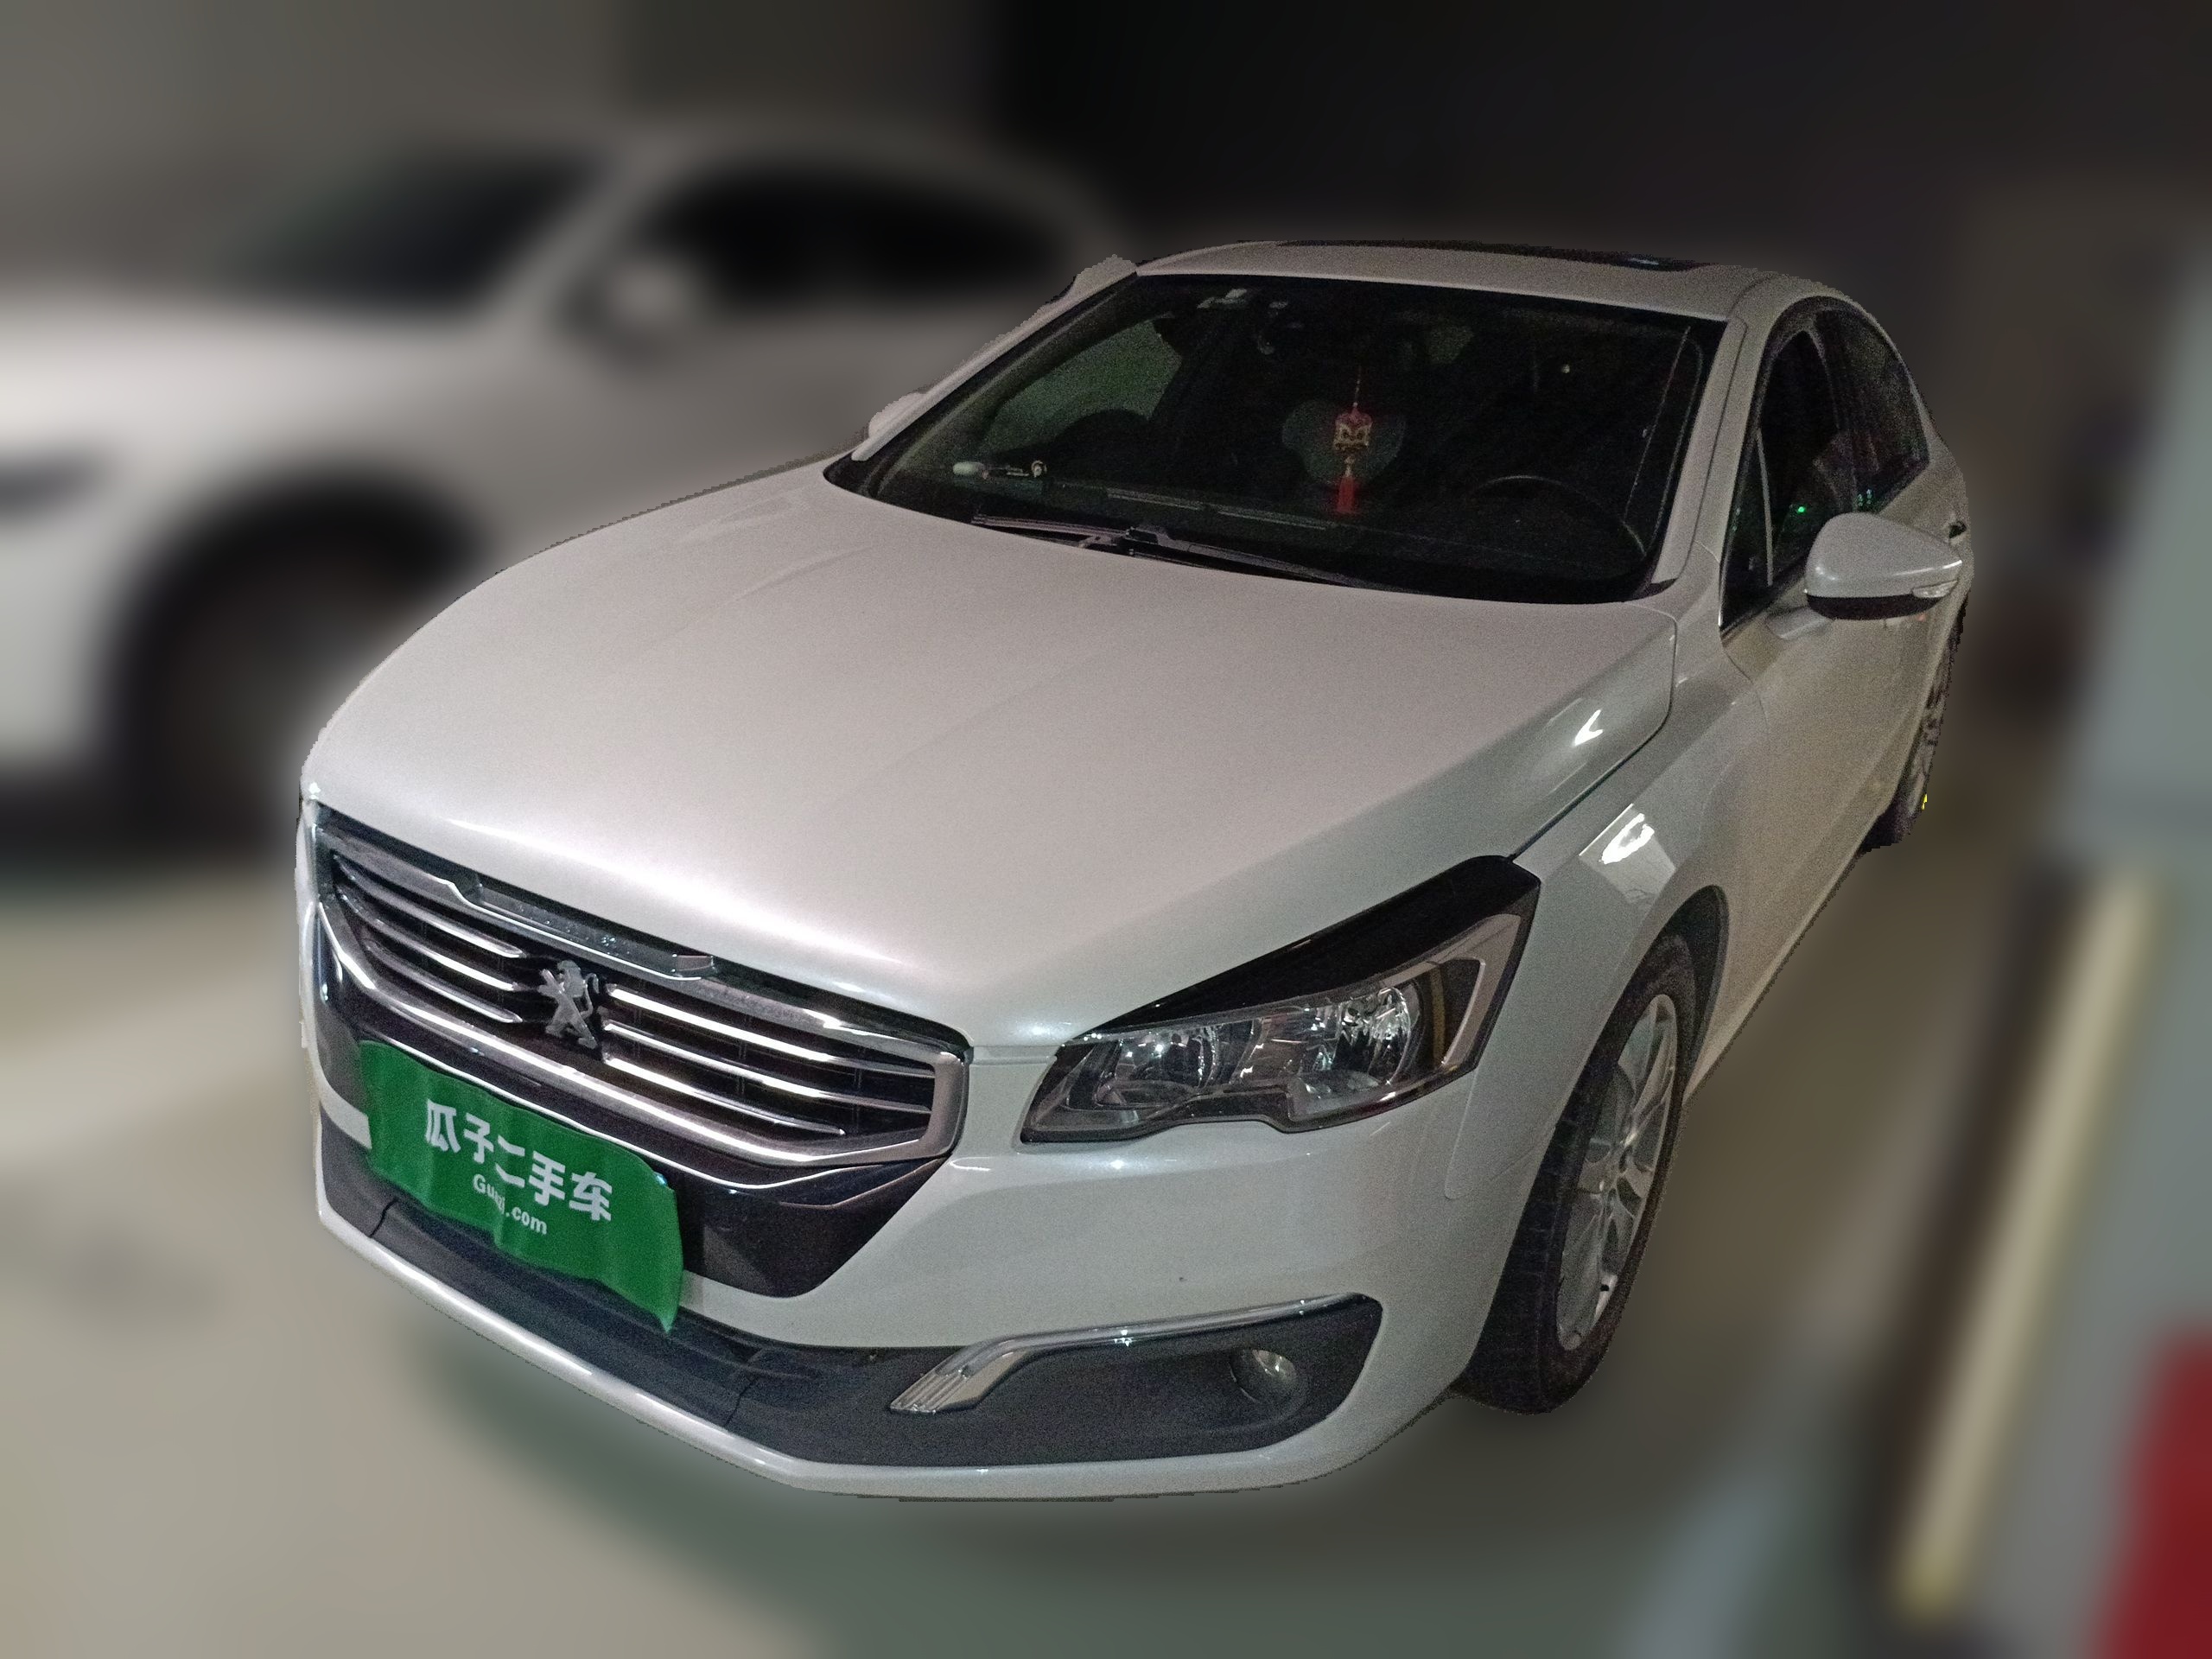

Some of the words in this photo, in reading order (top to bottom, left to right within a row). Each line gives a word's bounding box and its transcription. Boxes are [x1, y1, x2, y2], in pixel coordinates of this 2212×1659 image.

[425, 1099, 612, 1222] 瓜子二手车
